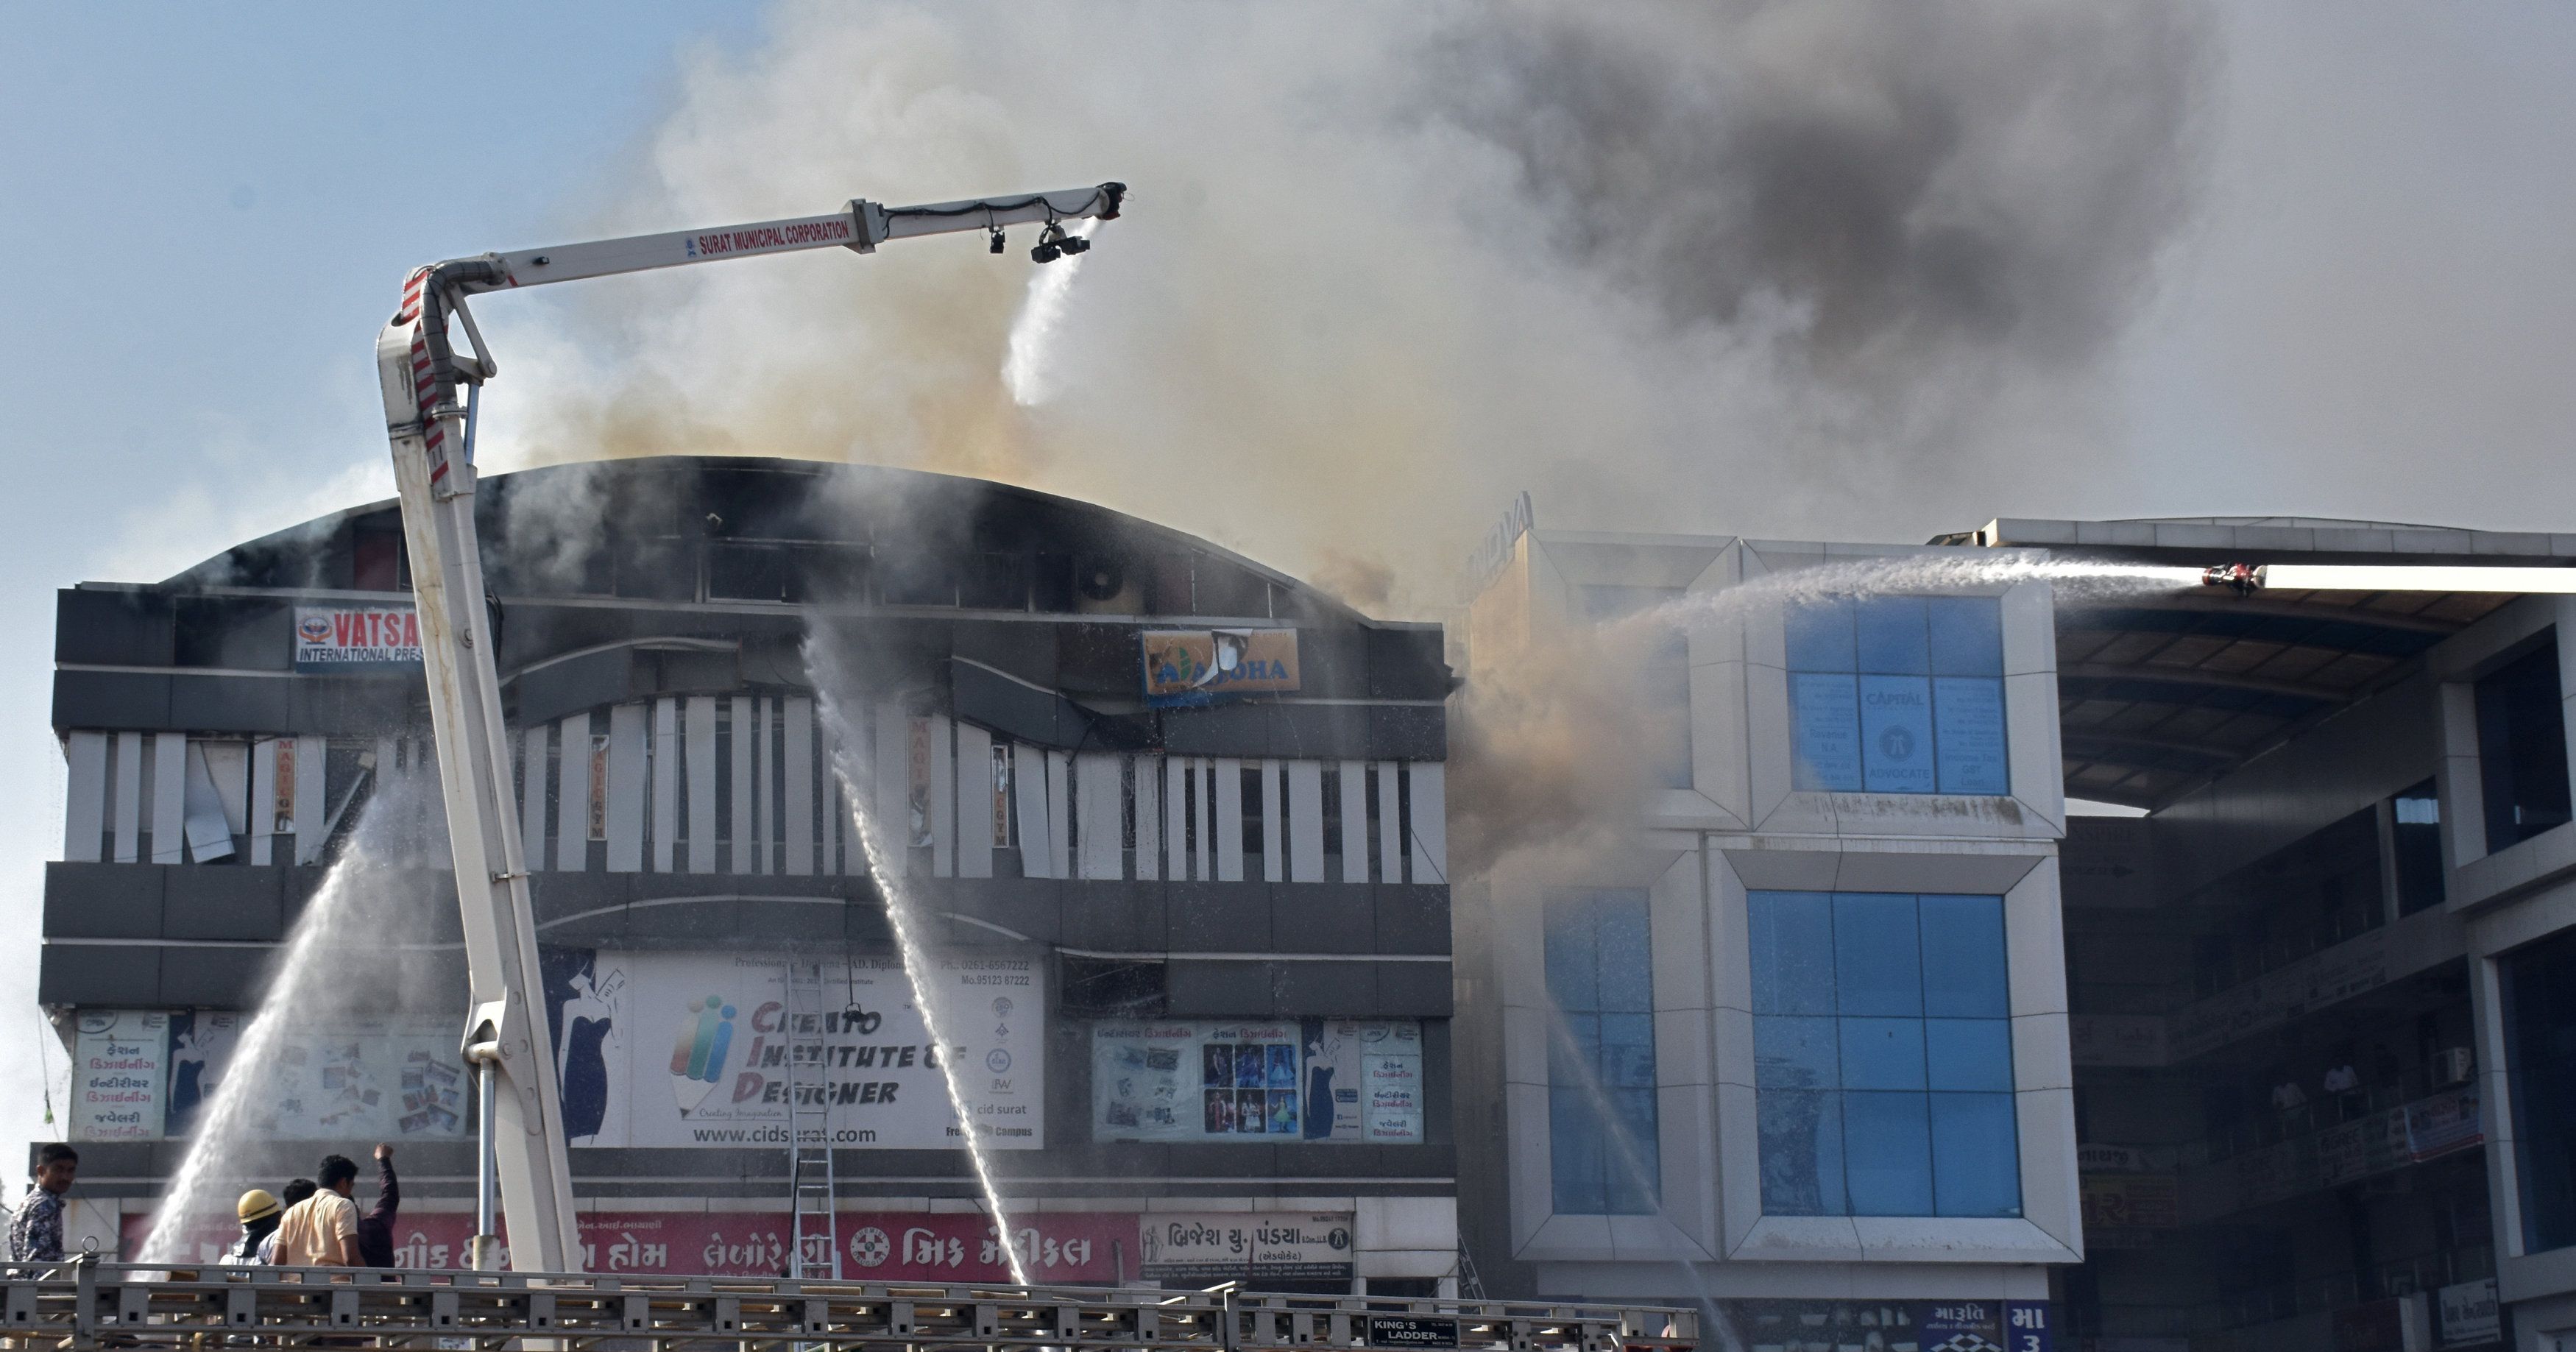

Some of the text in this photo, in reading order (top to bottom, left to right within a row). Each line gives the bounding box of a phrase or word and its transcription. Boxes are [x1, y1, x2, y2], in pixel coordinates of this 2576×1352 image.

[699, 220, 850, 255] SURAT MUNICIPAL CORPORATION
[300, 648, 391, 662] INTERNATIONAL
[1866, 691, 1925, 707] CAPITAL
[1869, 768, 1930, 779] ADVOCATE
[107, 1043, 140, 1057] ફેશન
[977, 1104, 1027, 1115] cid surat
[693, 1125, 877, 1142] www.cidsrat.com
[996, 1126, 1033, 1137] Campus
[609, 1231, 668, 1271] હોમ
[1374, 1320, 1417, 1329] KING'S
[1387, 1331, 1437, 1340] LADDER
